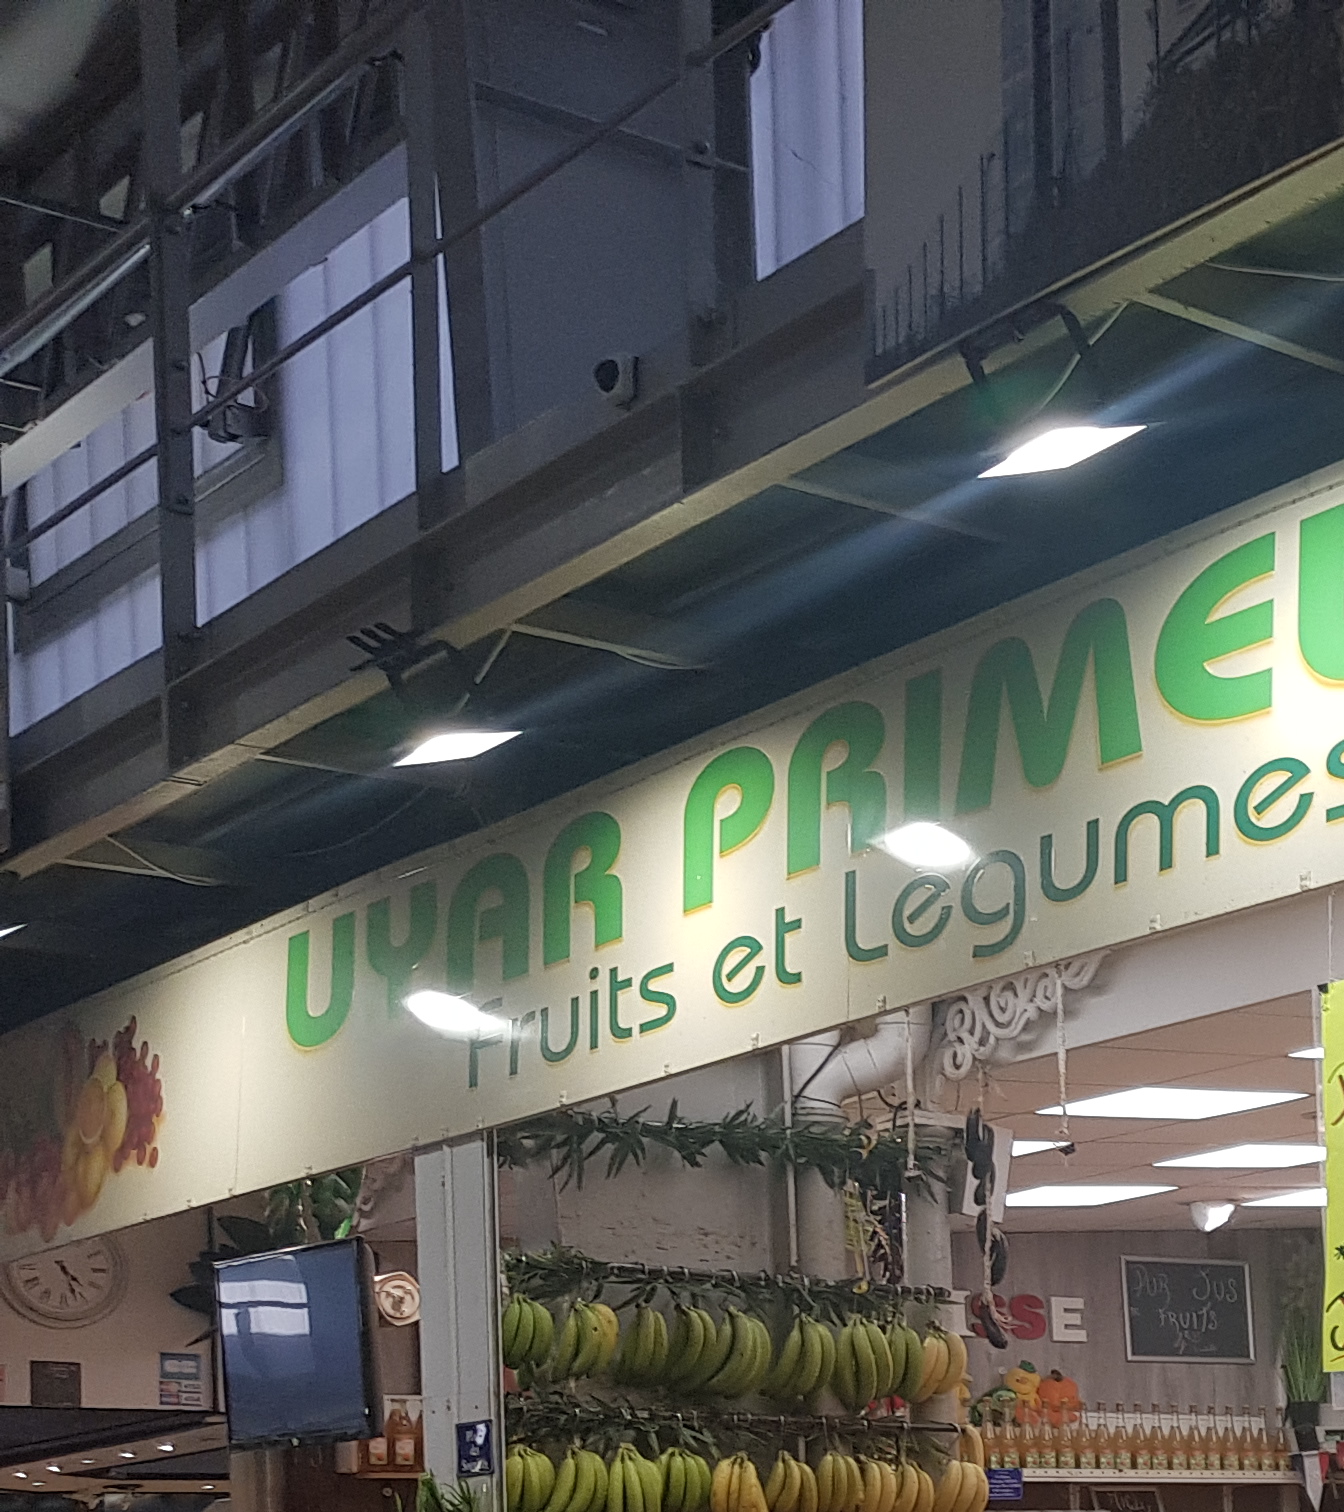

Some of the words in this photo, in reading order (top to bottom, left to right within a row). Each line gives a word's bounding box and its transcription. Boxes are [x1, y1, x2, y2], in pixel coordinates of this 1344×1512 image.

[287, 811, 623, 1048] UYAR
[469, 962, 675, 1088] Fruits
[713, 907, 802, 1005] et
[1159, 1302, 1218, 1333] FRUITS
[1193, 1267, 1238, 1303] JUS
